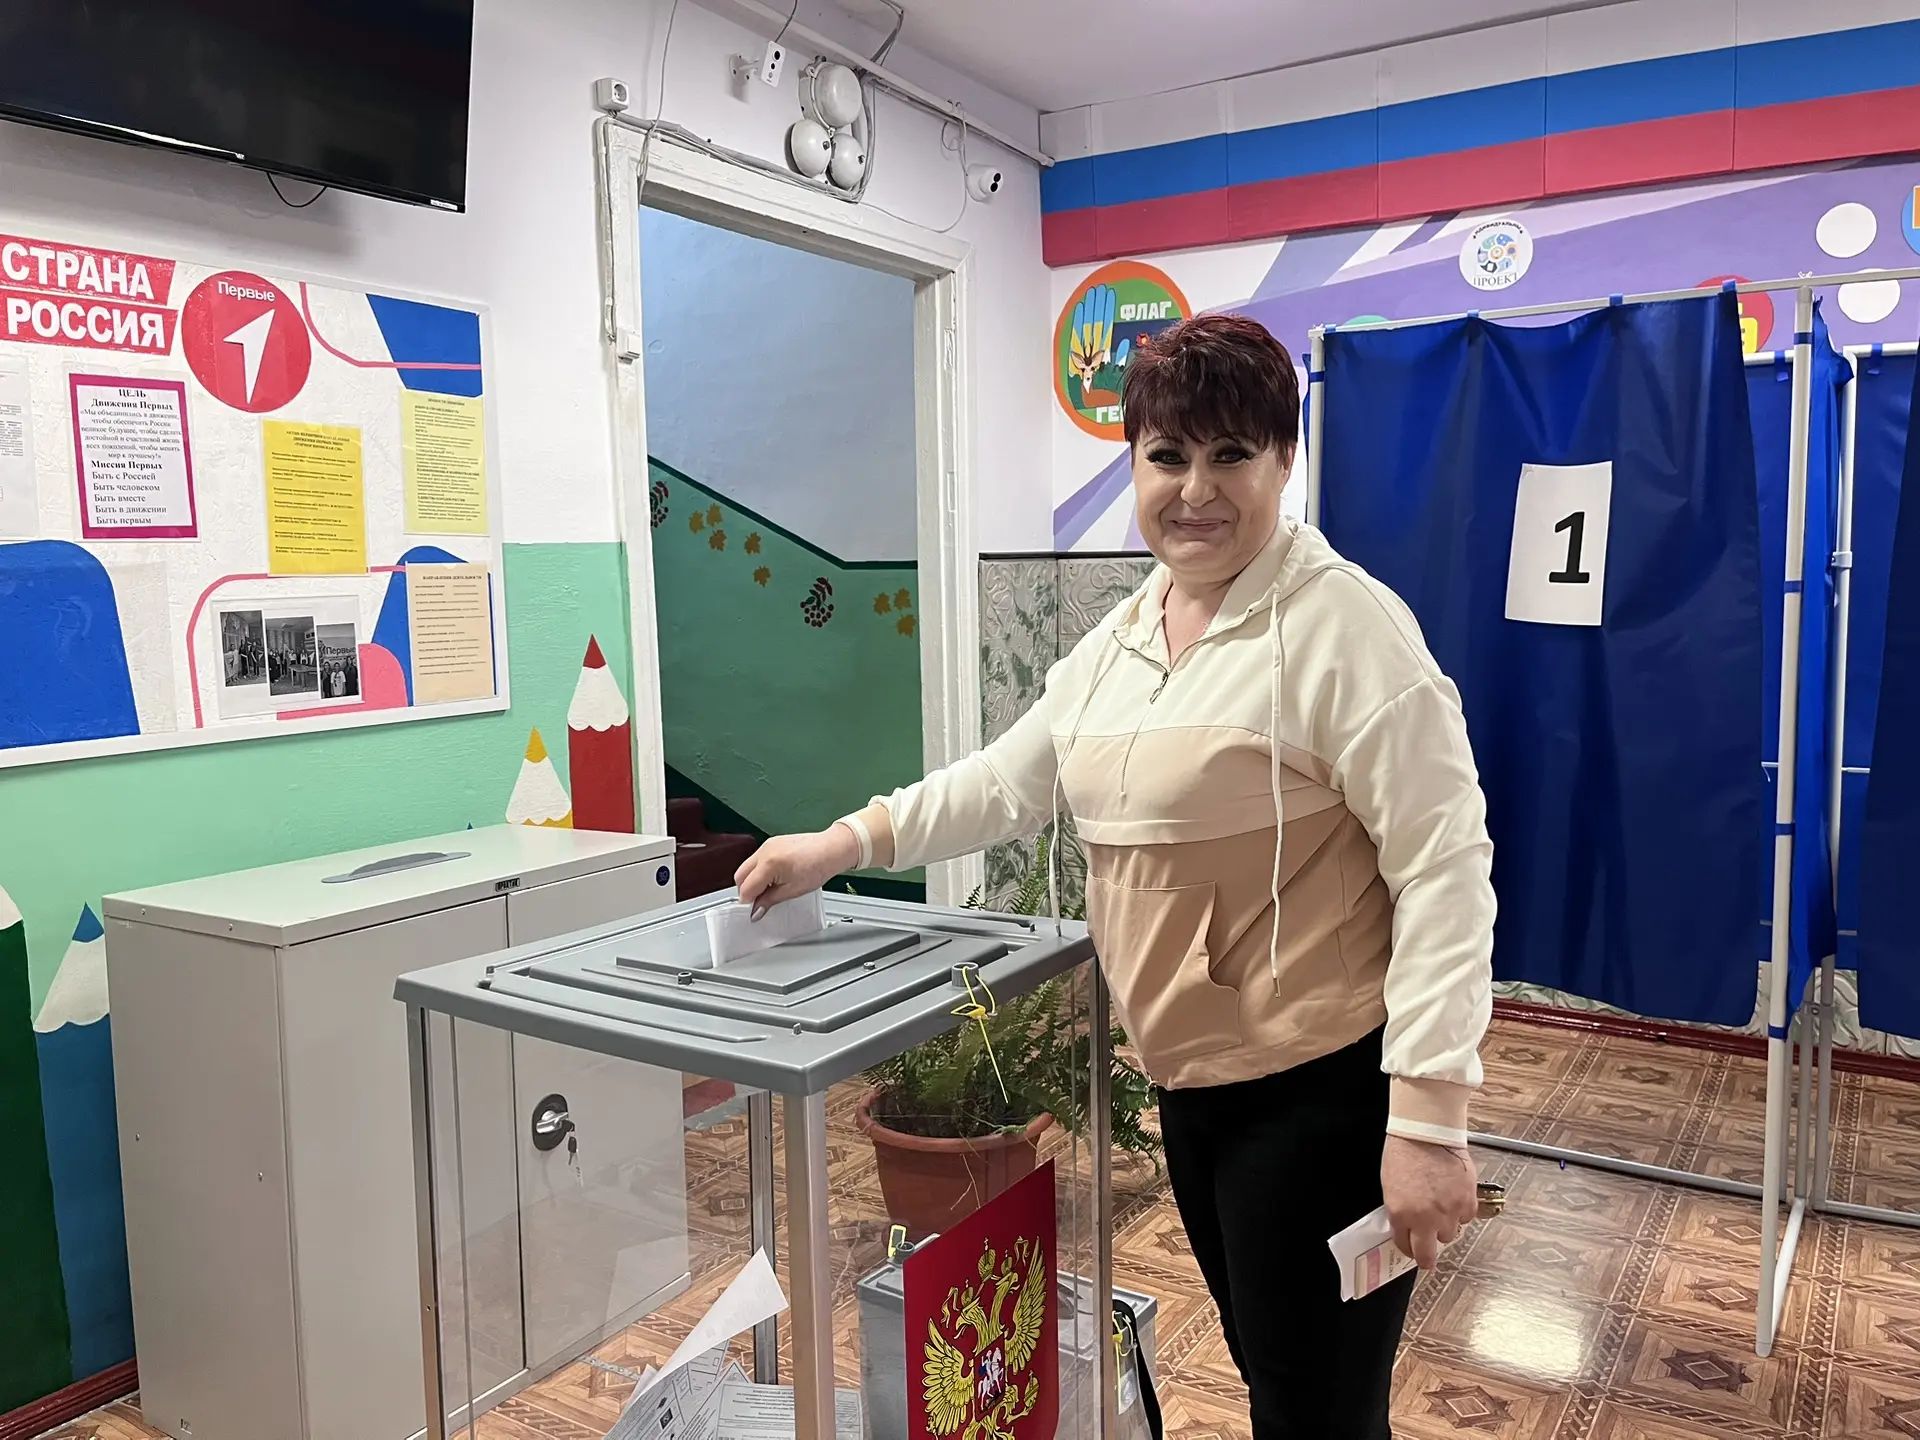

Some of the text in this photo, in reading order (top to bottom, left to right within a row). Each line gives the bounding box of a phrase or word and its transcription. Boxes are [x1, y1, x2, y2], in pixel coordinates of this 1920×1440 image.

[1, 242, 155, 300] СТРАНА
[1473, 271, 1517, 287] ПРОЕКТ
[218, 281, 275, 302] Первые
[1120, 301, 1172, 321] ФЛАГ
[6, 297, 166, 348] РОССИЯ
[118, 388, 147, 398] ЦЕЛЬ
[91, 398, 173, 411] Движения Первых
[1096, 405, 1124, 423] ГЕ
[91, 460, 163, 471] Миссия Первых
[92, 471, 114, 479] Быть
[122, 472, 156, 480] Россией
[93, 483, 115, 491] Быть
[94, 494, 116, 502] Быть
[95, 505, 117, 513] Быть
[1549, 511, 1590, 583] 1
